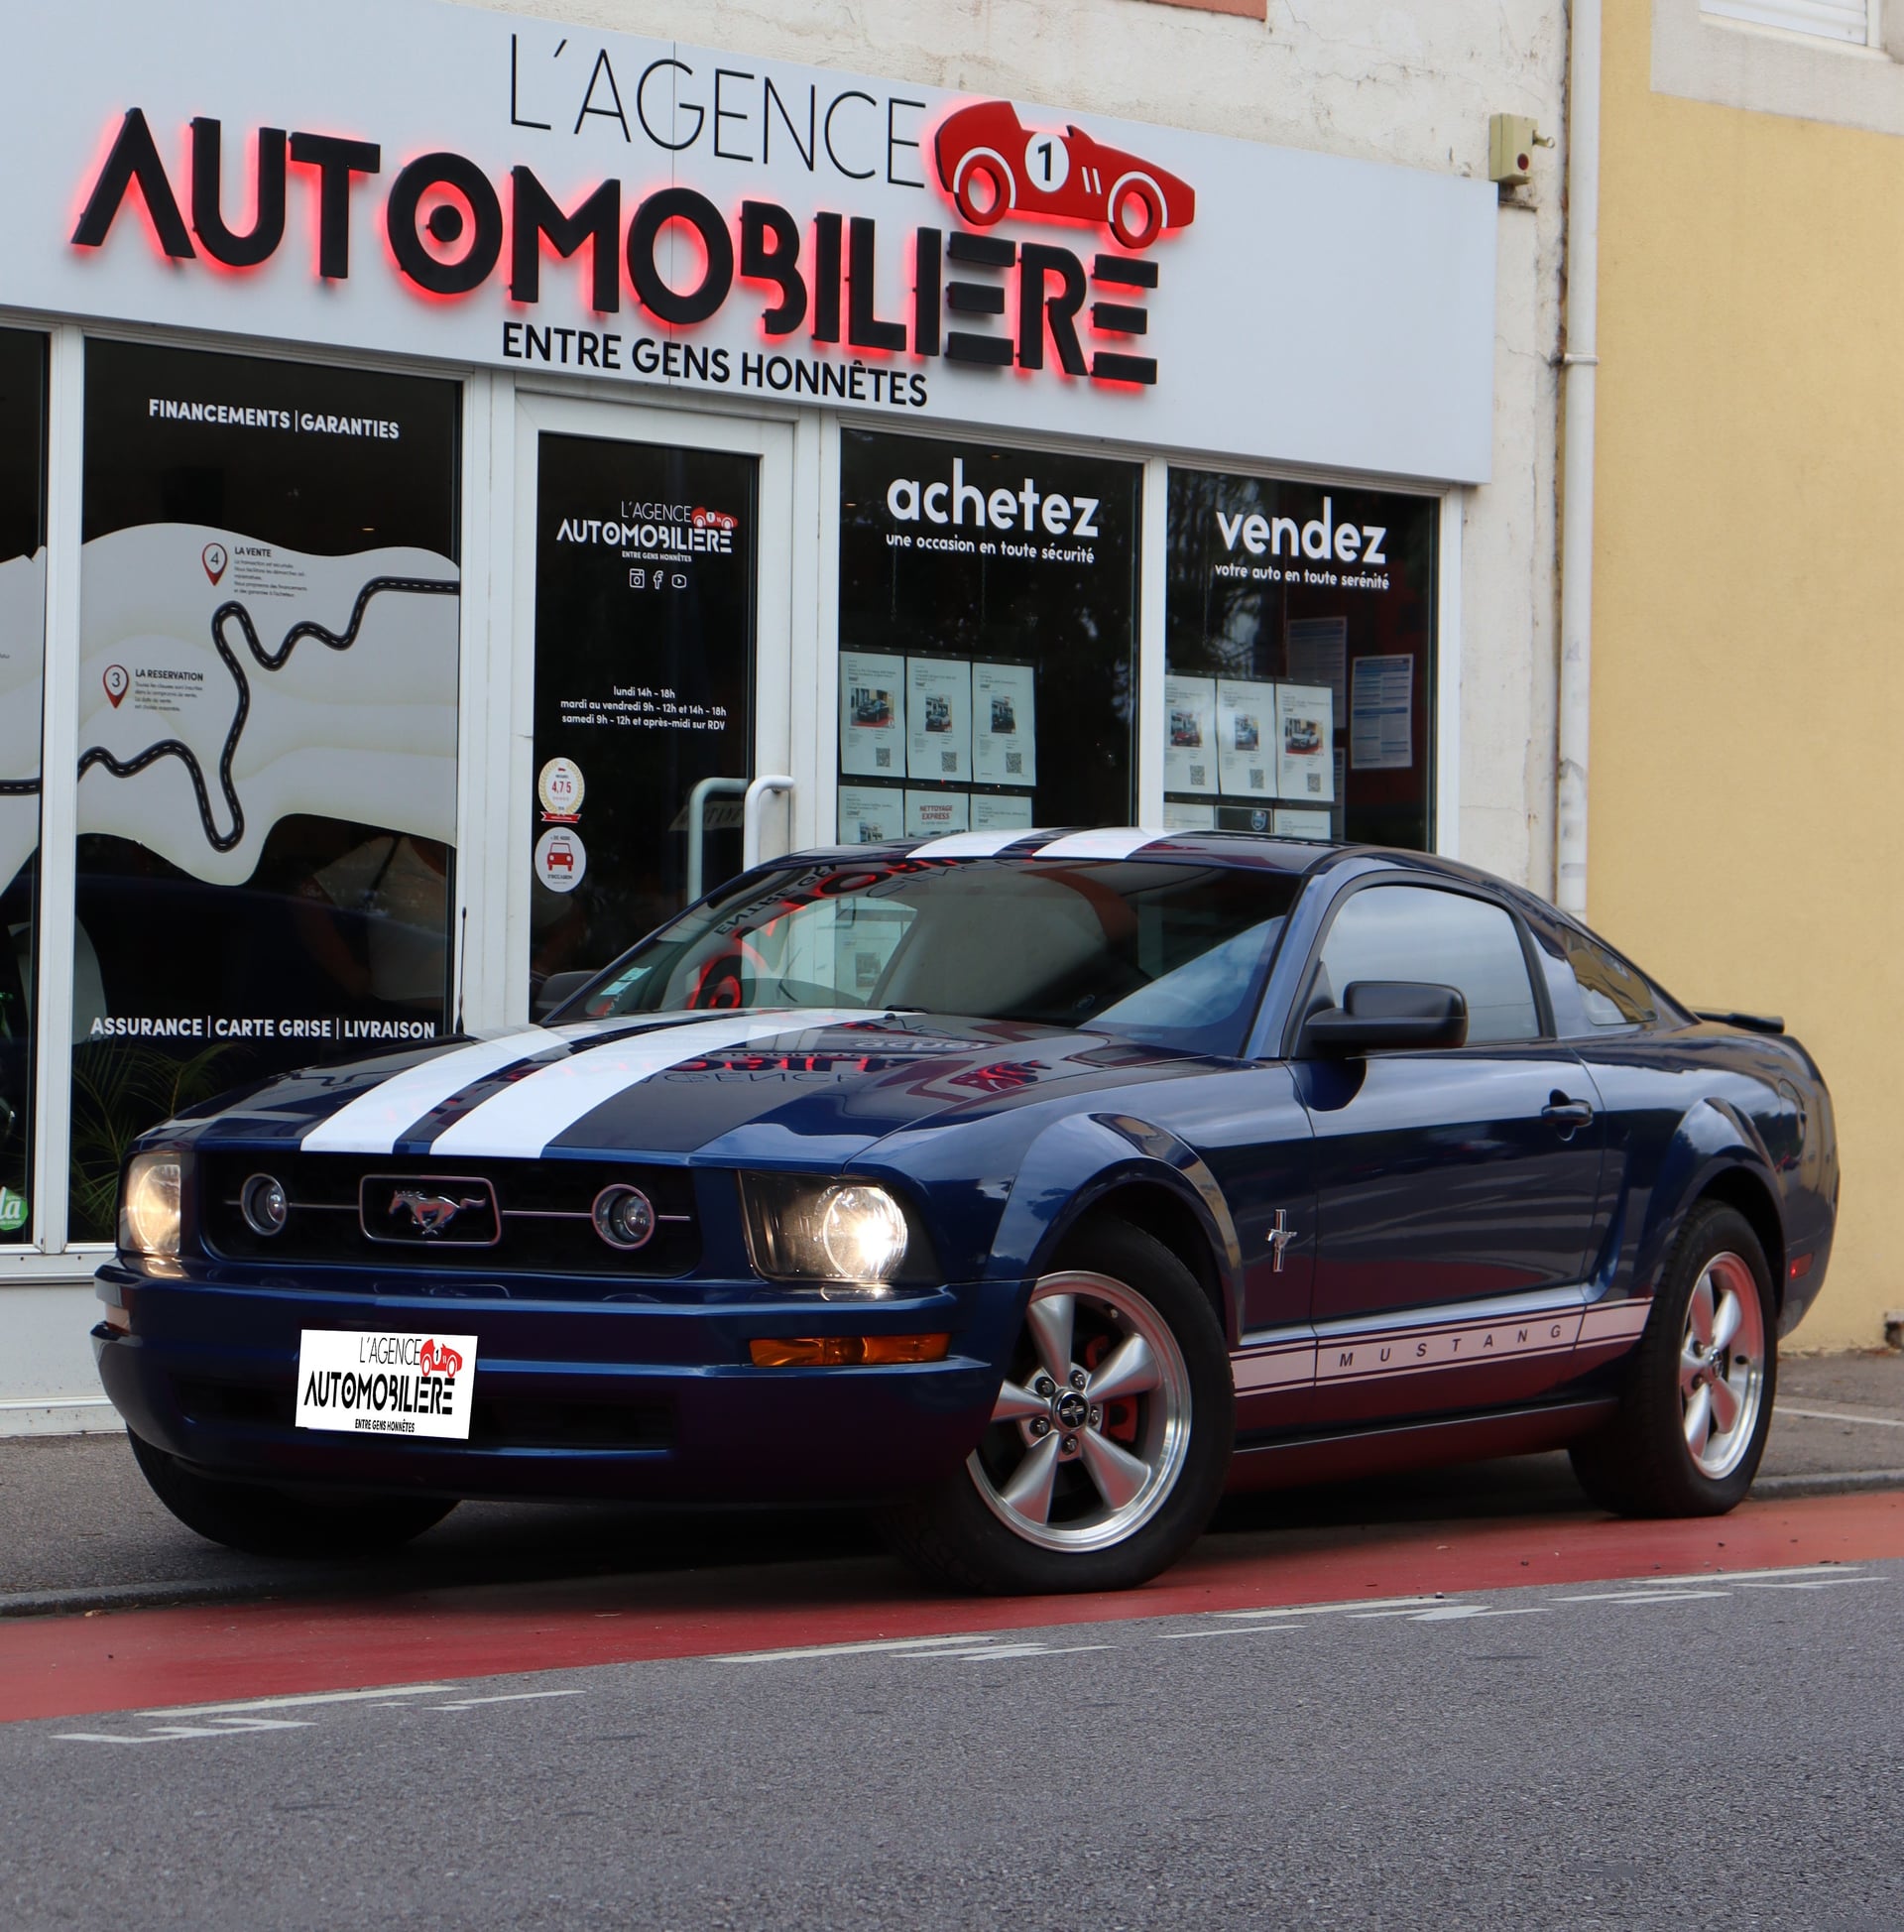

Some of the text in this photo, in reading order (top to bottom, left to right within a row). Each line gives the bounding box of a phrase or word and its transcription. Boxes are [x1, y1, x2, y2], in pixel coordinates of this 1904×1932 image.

[510, 33, 927, 189] L'AGENCE
[1036, 141, 1053, 183] 1
[503, 320, 927, 408] ENTRE GENS HONNÊTES
[149, 398, 400, 439] FINANCEMENTS GARANTIES
[886, 456, 1100, 539] achetez
[621, 500, 692, 524] L'AGENCE
[1215, 496, 1387, 565] vendez
[209, 551, 220, 565] 4
[234, 546, 272, 557] LA VENTE
[621, 549, 692, 562] ENTRE GENS HONNÊTES
[886, 534, 1095, 564] une occasion en toute sécurité
[1214, 562, 1249, 578] votre
[1251, 565, 1281, 581] auto
[1284, 570, 1301, 582] en
[1303, 568, 1338, 586] toute
[111, 671, 121, 688] 3
[135, 668, 204, 682] LA RESERVATION
[613, 685, 636, 697] lundi
[637, 686, 653, 697] 14h
[659, 688, 676, 699] 18h
[560, 698, 588, 709] mardi
[588, 701, 601, 710] au
[602, 700, 642, 712] vendredi
[643, 701, 654, 712] 9h
[661, 702, 677, 713] 12h
[677, 704, 688, 714] et
[688, 704, 704, 715] 14h
[711, 705, 727, 717] 18h
[561, 713, 595, 724] samedi
[596, 714, 609, 725] 9h
[616, 714, 632, 726] 12h
[632, 716, 642, 726] et
[643, 716, 691, 729] après-midi
[692, 721, 707, 730] sur
[707, 719, 726, 731] RDV
[919, 804, 953, 813] NETTOYAGE
[89, 1016, 435, 1040] ASSURANCE CARTE GRISE LIVRAISON
